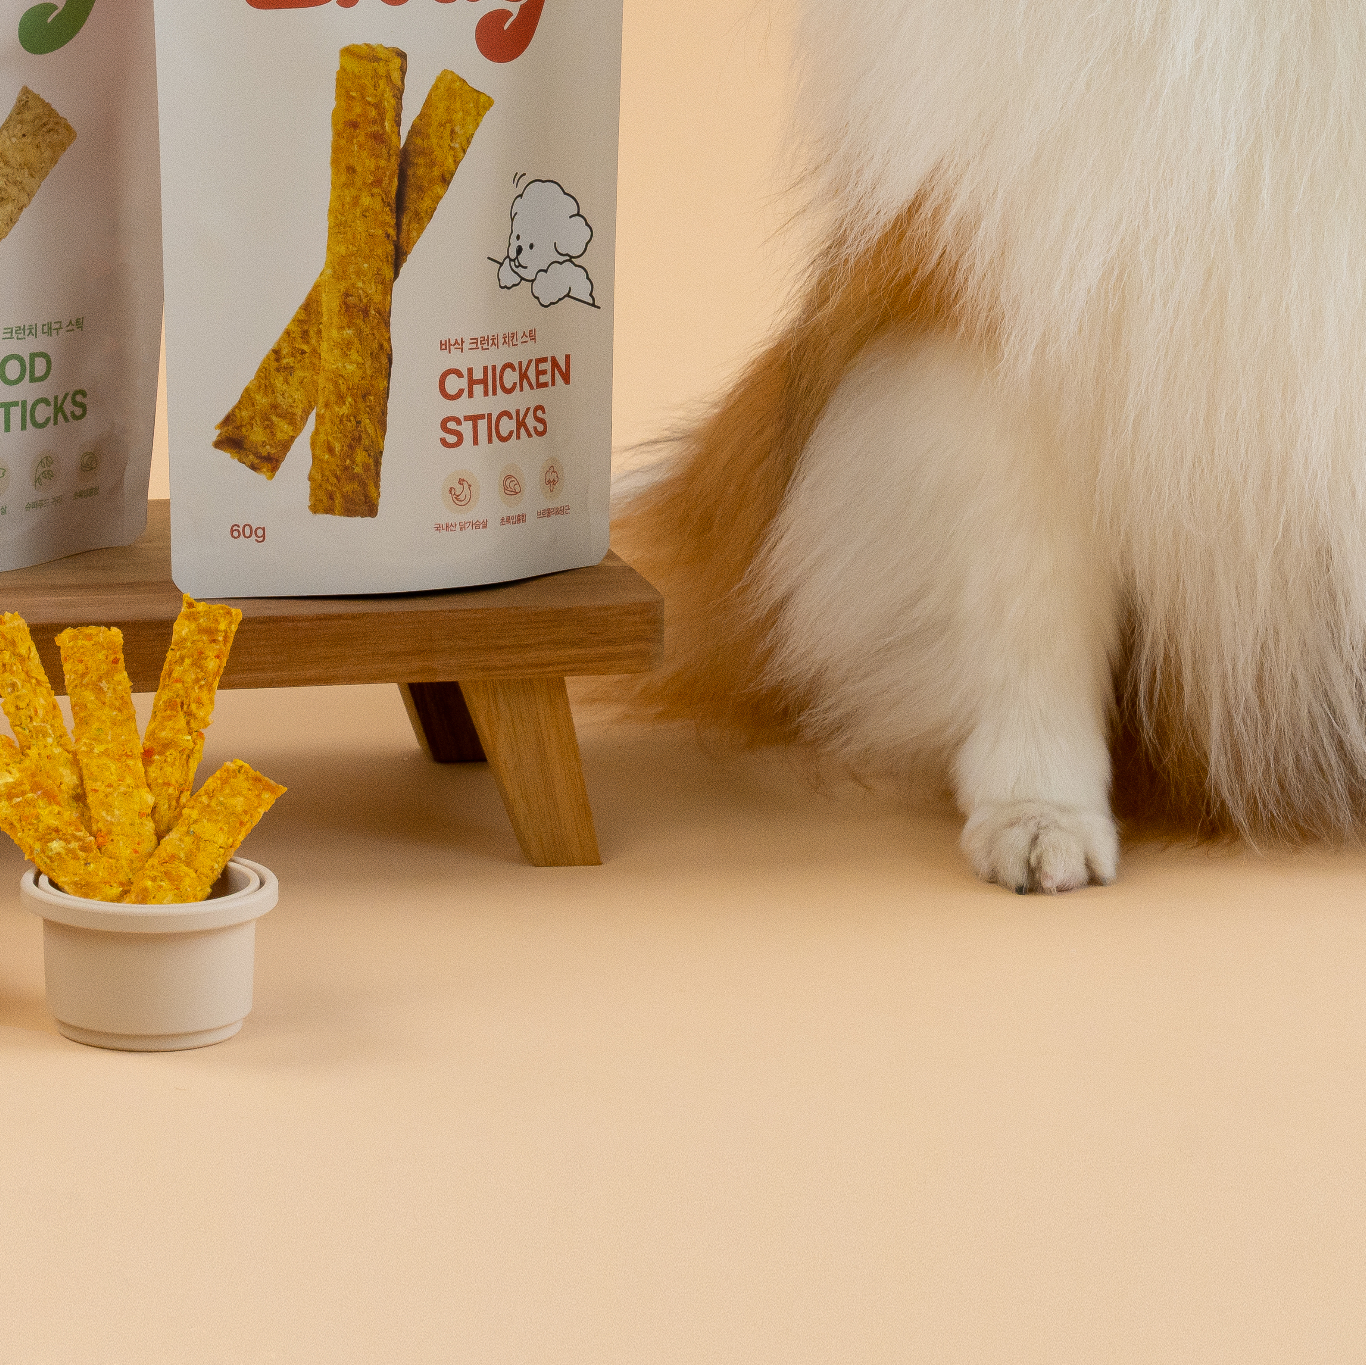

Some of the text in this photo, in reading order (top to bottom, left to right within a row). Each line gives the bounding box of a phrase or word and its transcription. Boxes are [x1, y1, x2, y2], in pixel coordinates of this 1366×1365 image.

[2, 322, 38, 341] 크런치
[41, 320, 63, 337] 대구
[66, 316, 84, 333] 스틱
[439, 327, 537, 354] 바삭 크런치 치킨 스틱
[438, 353, 572, 401] CHICKEN
[439, 404, 548, 449] STICKS
[229, 523, 267, 543] 60g
[433, 518, 489, 533] 국내산 닭가슴살
